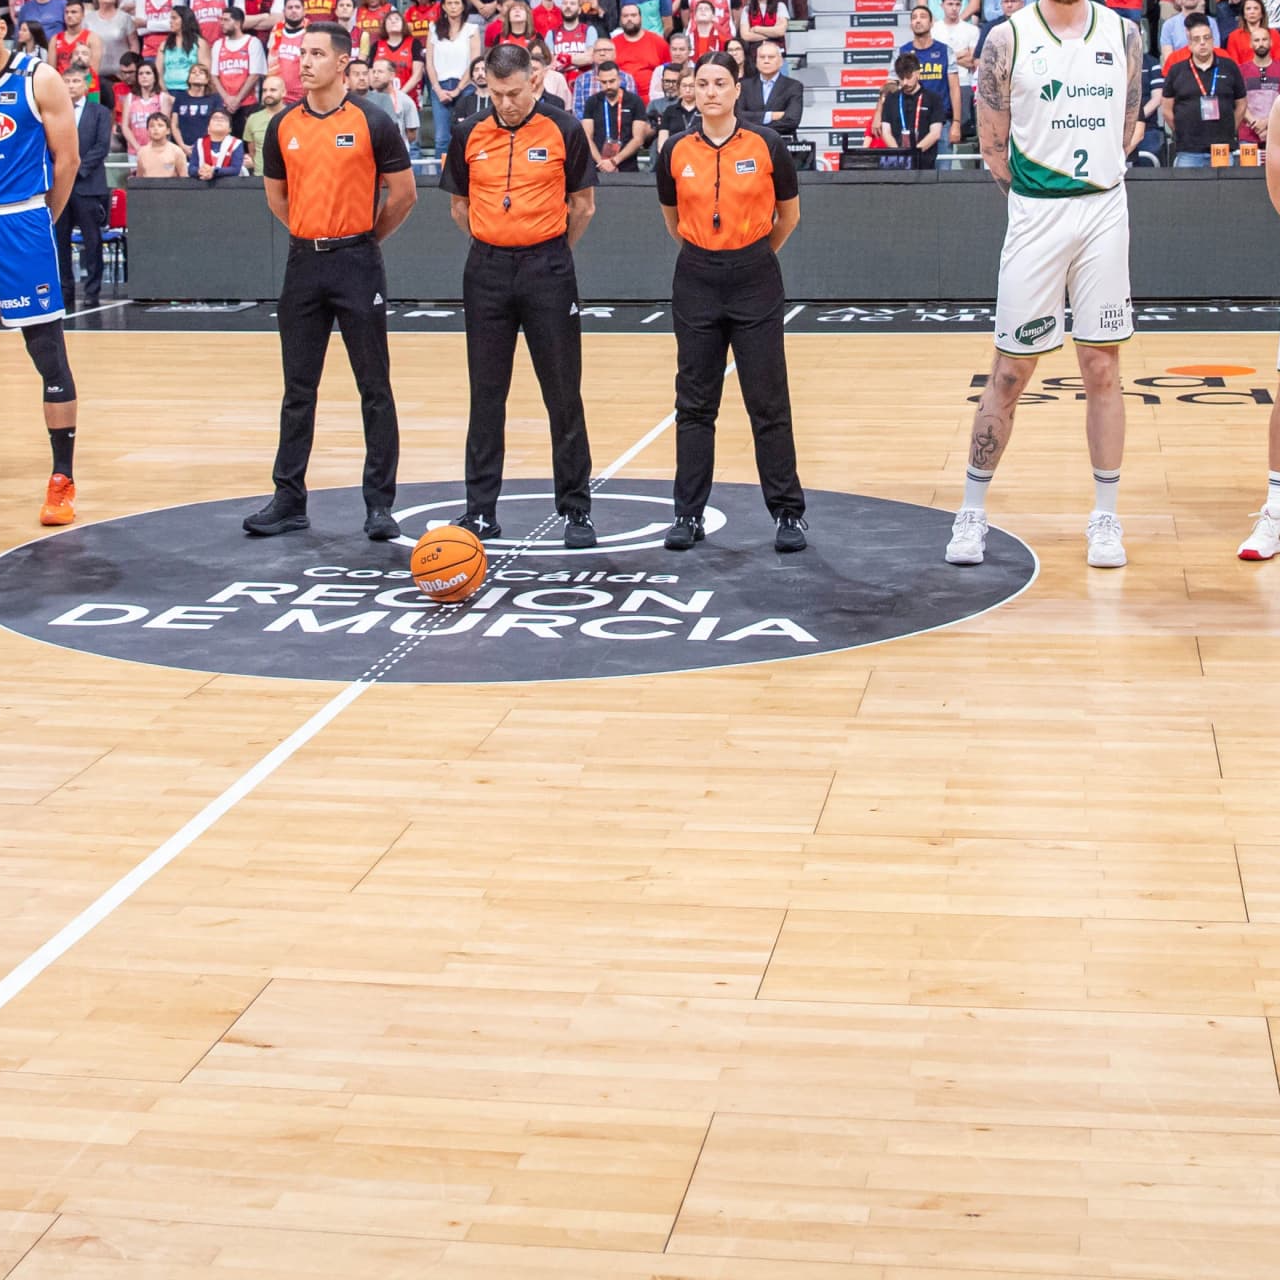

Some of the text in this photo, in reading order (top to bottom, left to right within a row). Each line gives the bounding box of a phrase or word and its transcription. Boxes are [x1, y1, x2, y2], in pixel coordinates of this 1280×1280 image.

[1067, 84, 1113, 99] Unicaja
[1074, 149, 1088, 177] 2
[420, 572, 468, 592] Wilson
[494, 567, 680, 587] Cálida
[47, 603, 821, 644] DE MURCIA
